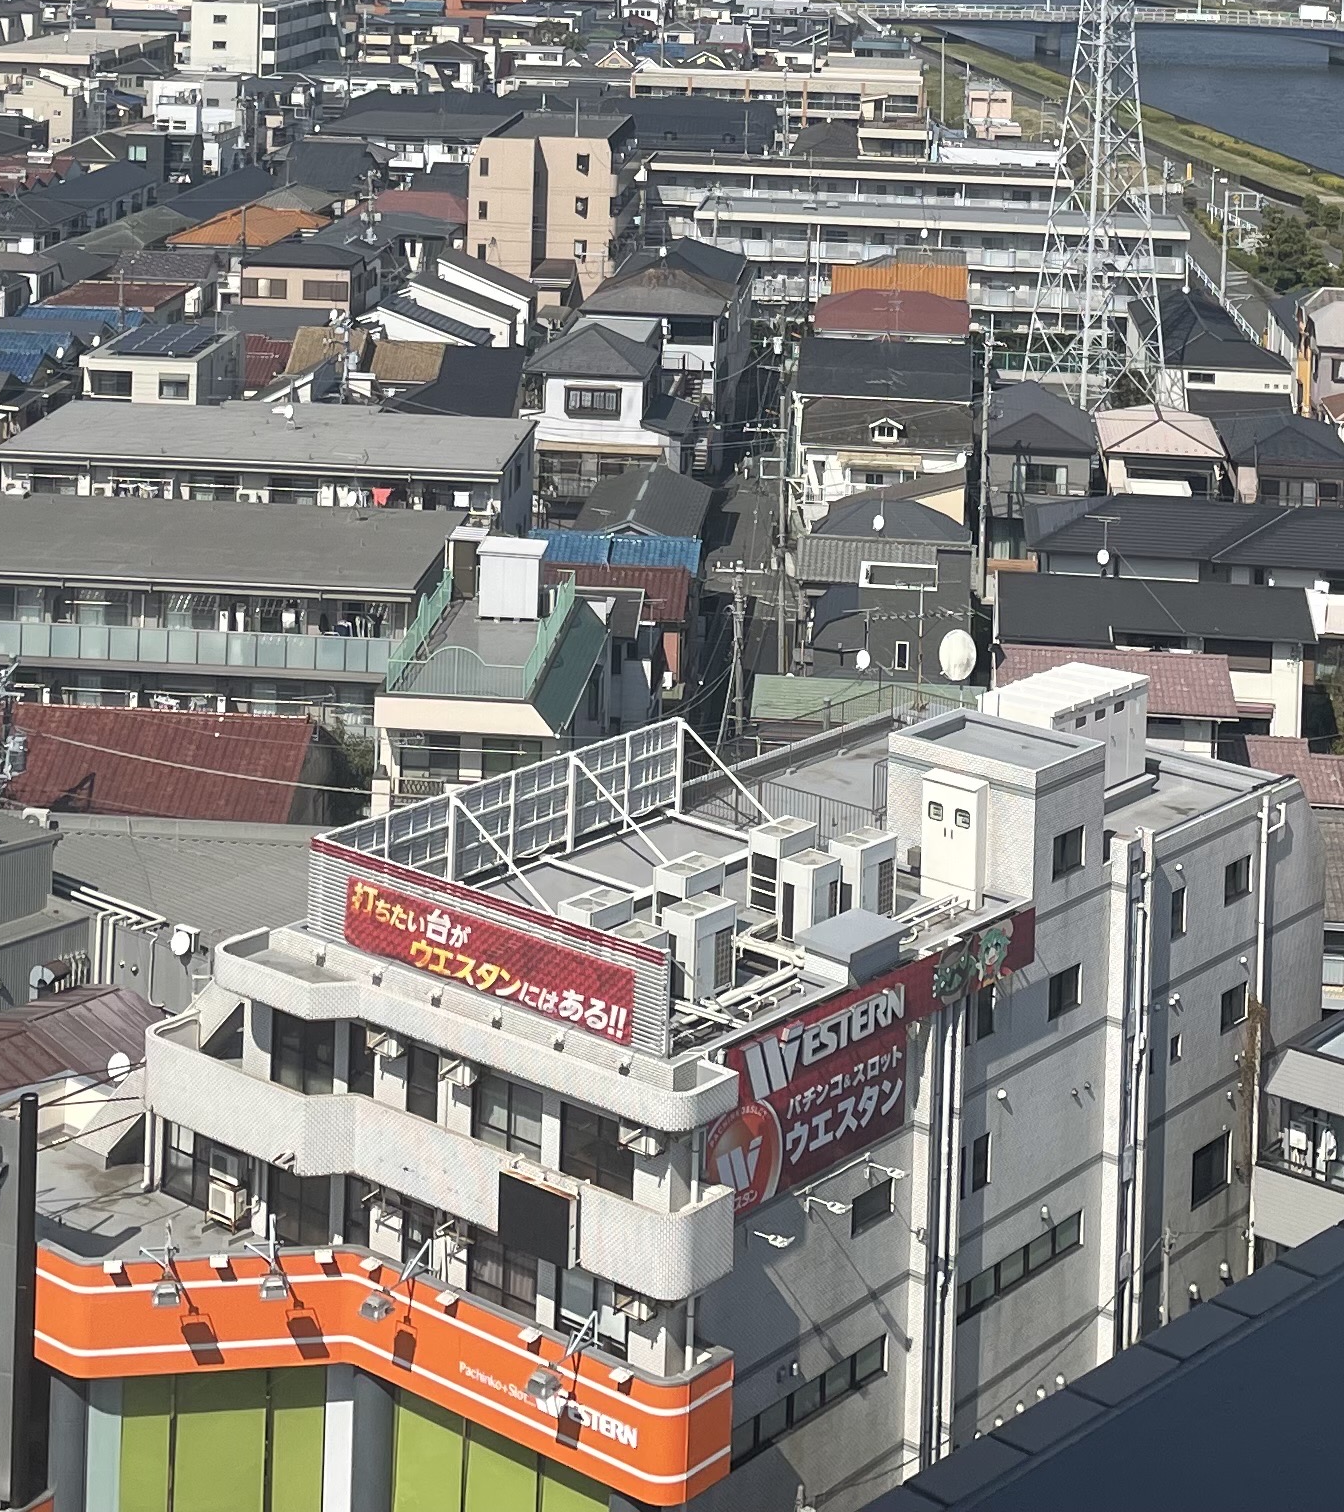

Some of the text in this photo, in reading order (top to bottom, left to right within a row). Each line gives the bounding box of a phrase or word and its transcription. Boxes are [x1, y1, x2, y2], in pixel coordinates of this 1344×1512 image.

[353, 882, 472, 948] 打ちたい台が
[741, 983, 905, 1101] WESTERN
[787, 1045, 903, 1119] パチンコ&スロット
[786, 1078, 904, 1165] ウエスタン
[733, 1188, 759, 1212] スタン
